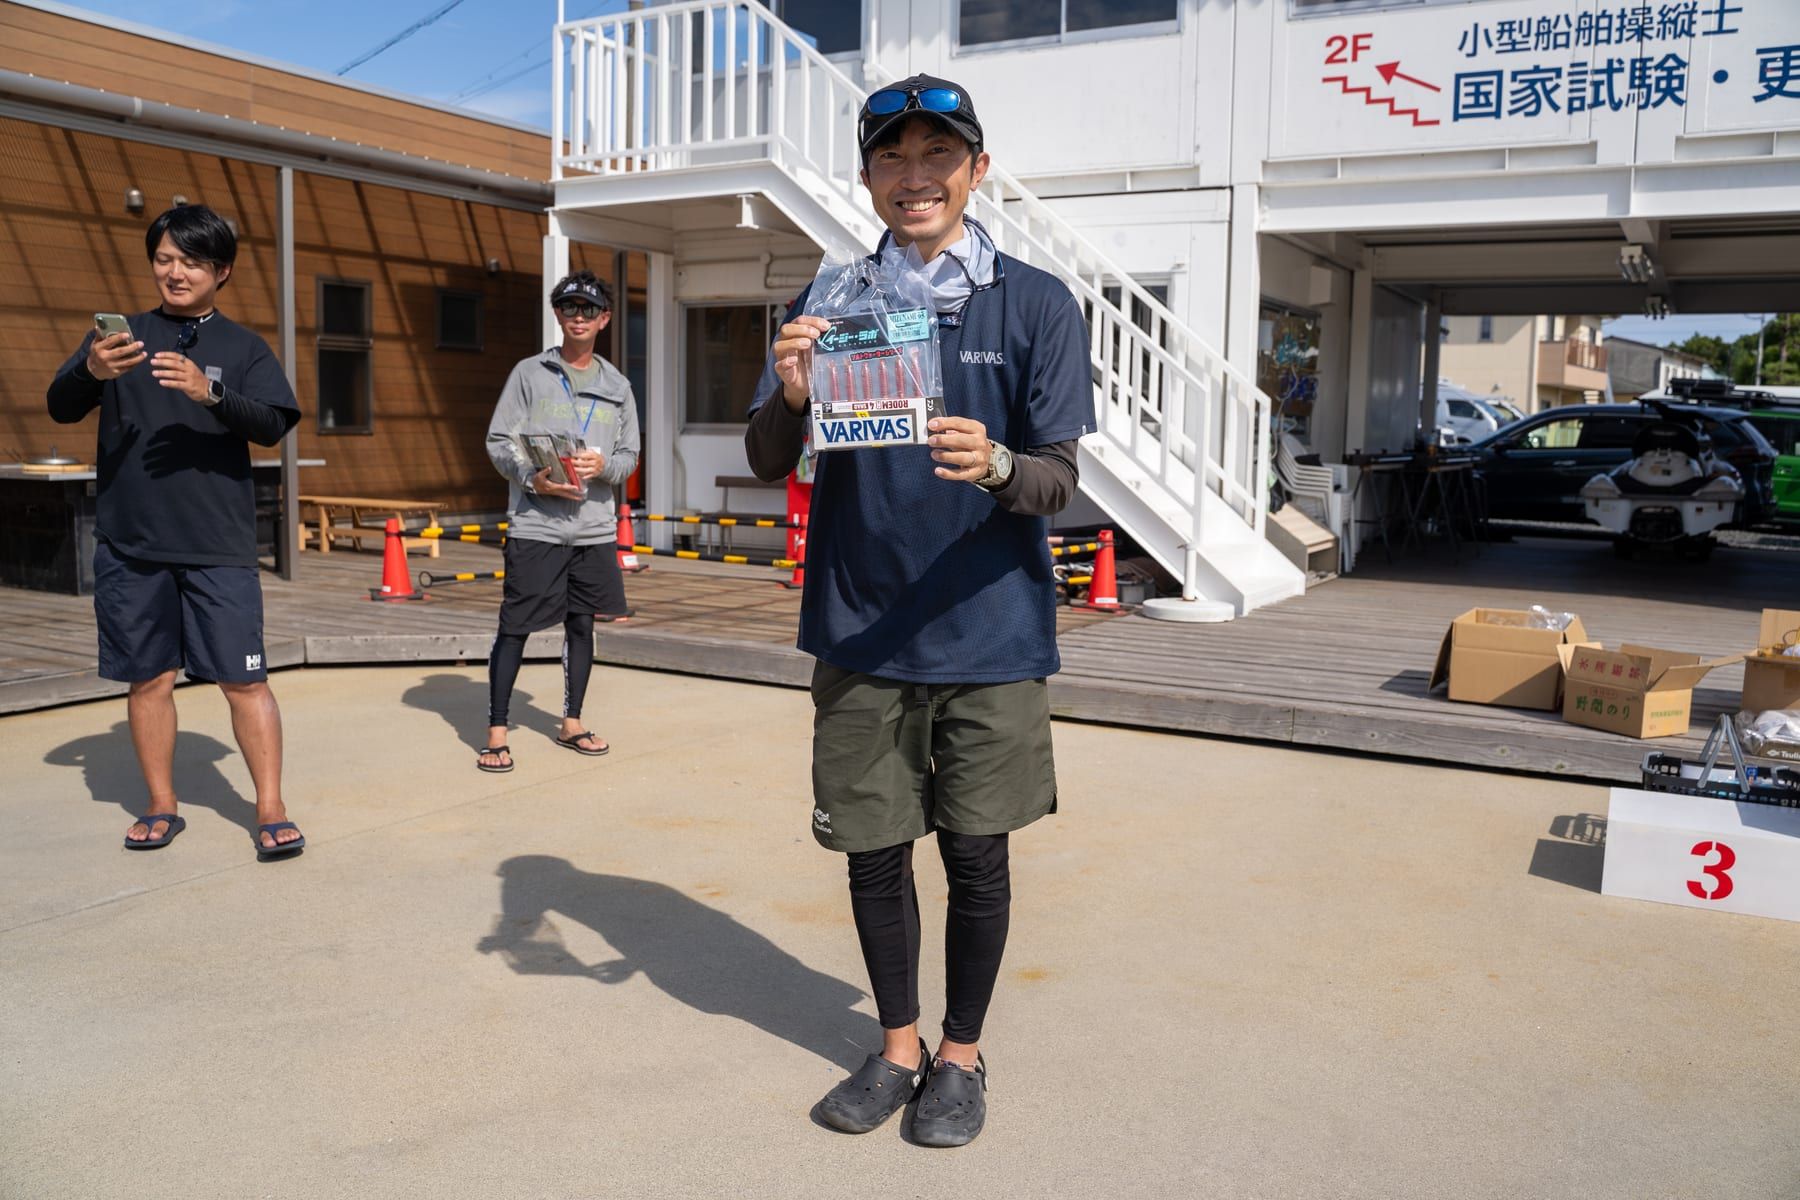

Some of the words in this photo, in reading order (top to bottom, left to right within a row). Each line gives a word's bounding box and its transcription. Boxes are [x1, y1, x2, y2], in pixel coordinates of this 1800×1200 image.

[1458, 0, 1743, 58] 小型船舶操縦士
[1325, 33, 1373, 64] 2F
[960, 350, 1004, 365] VARIVAS
[819, 418, 911, 443] VARIVAS
[1686, 841, 1736, 900] 3
